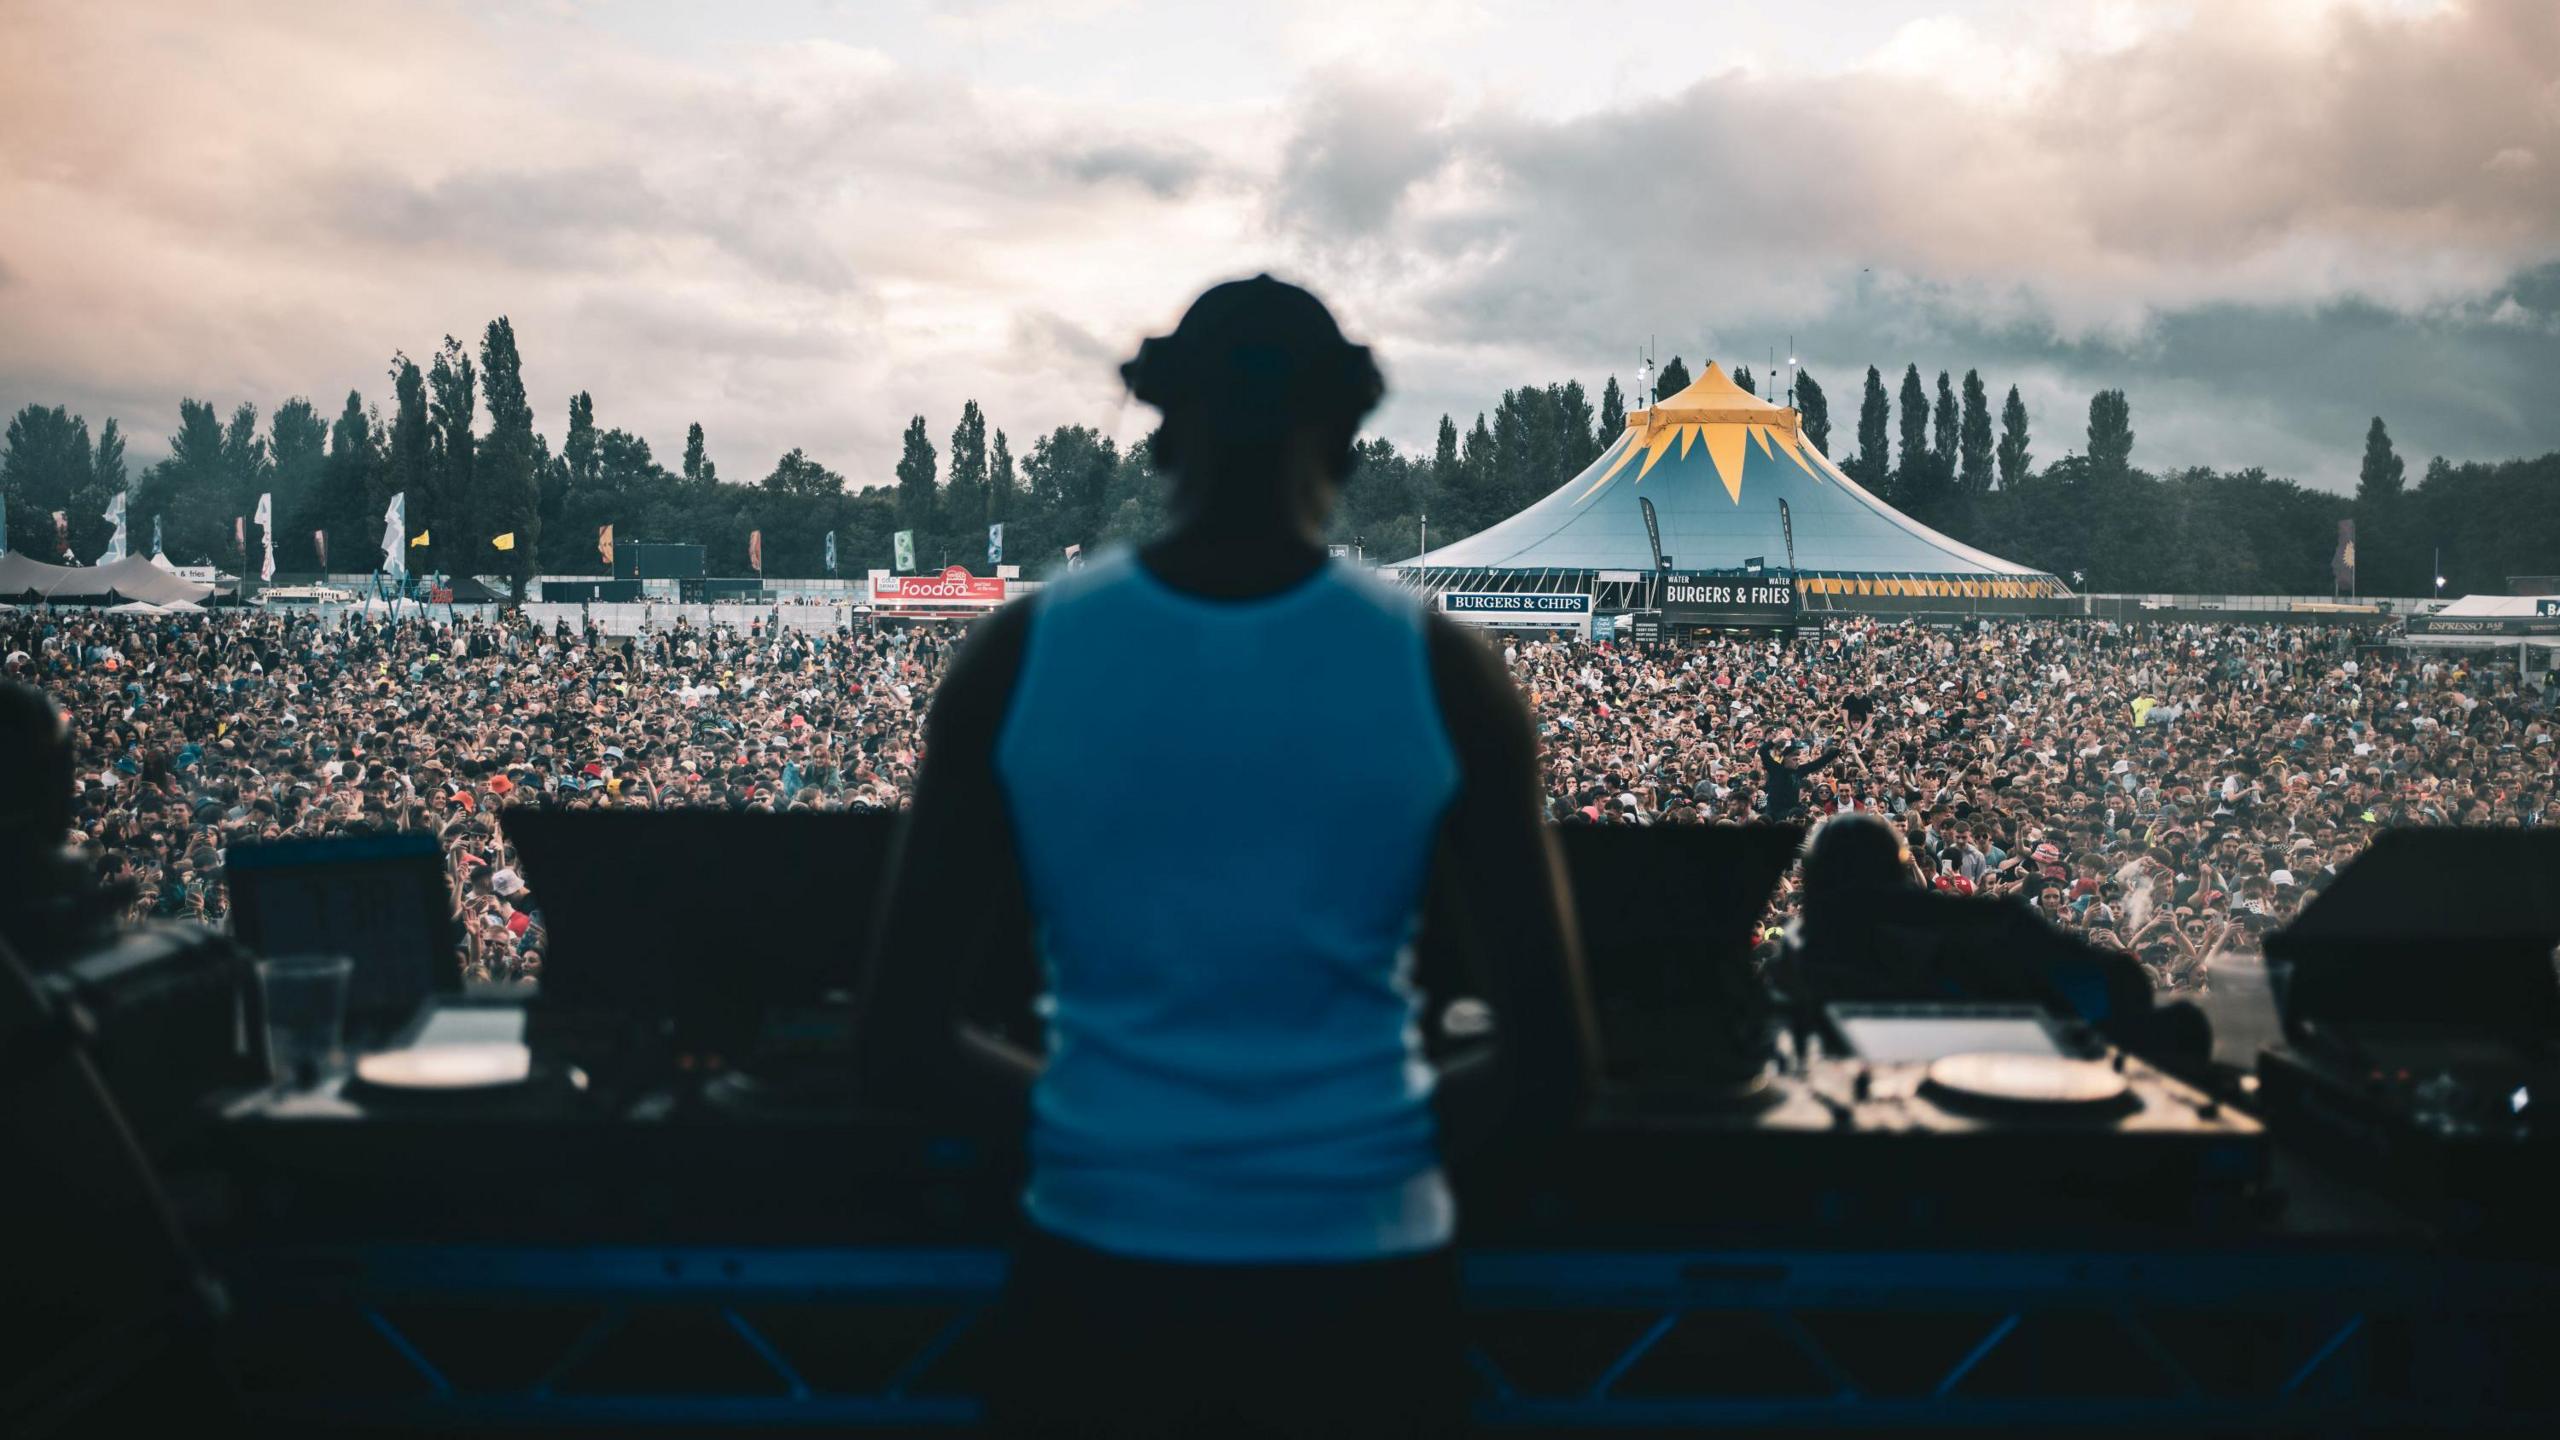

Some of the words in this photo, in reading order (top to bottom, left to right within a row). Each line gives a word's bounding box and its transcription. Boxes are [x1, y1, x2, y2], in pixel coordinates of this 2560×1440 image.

[1667, 575, 1690, 583] WATER
[1768, 577, 1790, 585] WATER
[901, 581, 968, 596] foodoo
[1666, 586, 1731, 603] BURGERS
[1736, 587, 1747, 603] &
[1751, 587, 1790, 604] FRIES
[1455, 596, 1521, 609] BURGERS
[1523, 597, 1535, 609] &
[1537, 597, 1582, 610] CHIPS
[2428, 621, 2482, 631] ESPRESSO
